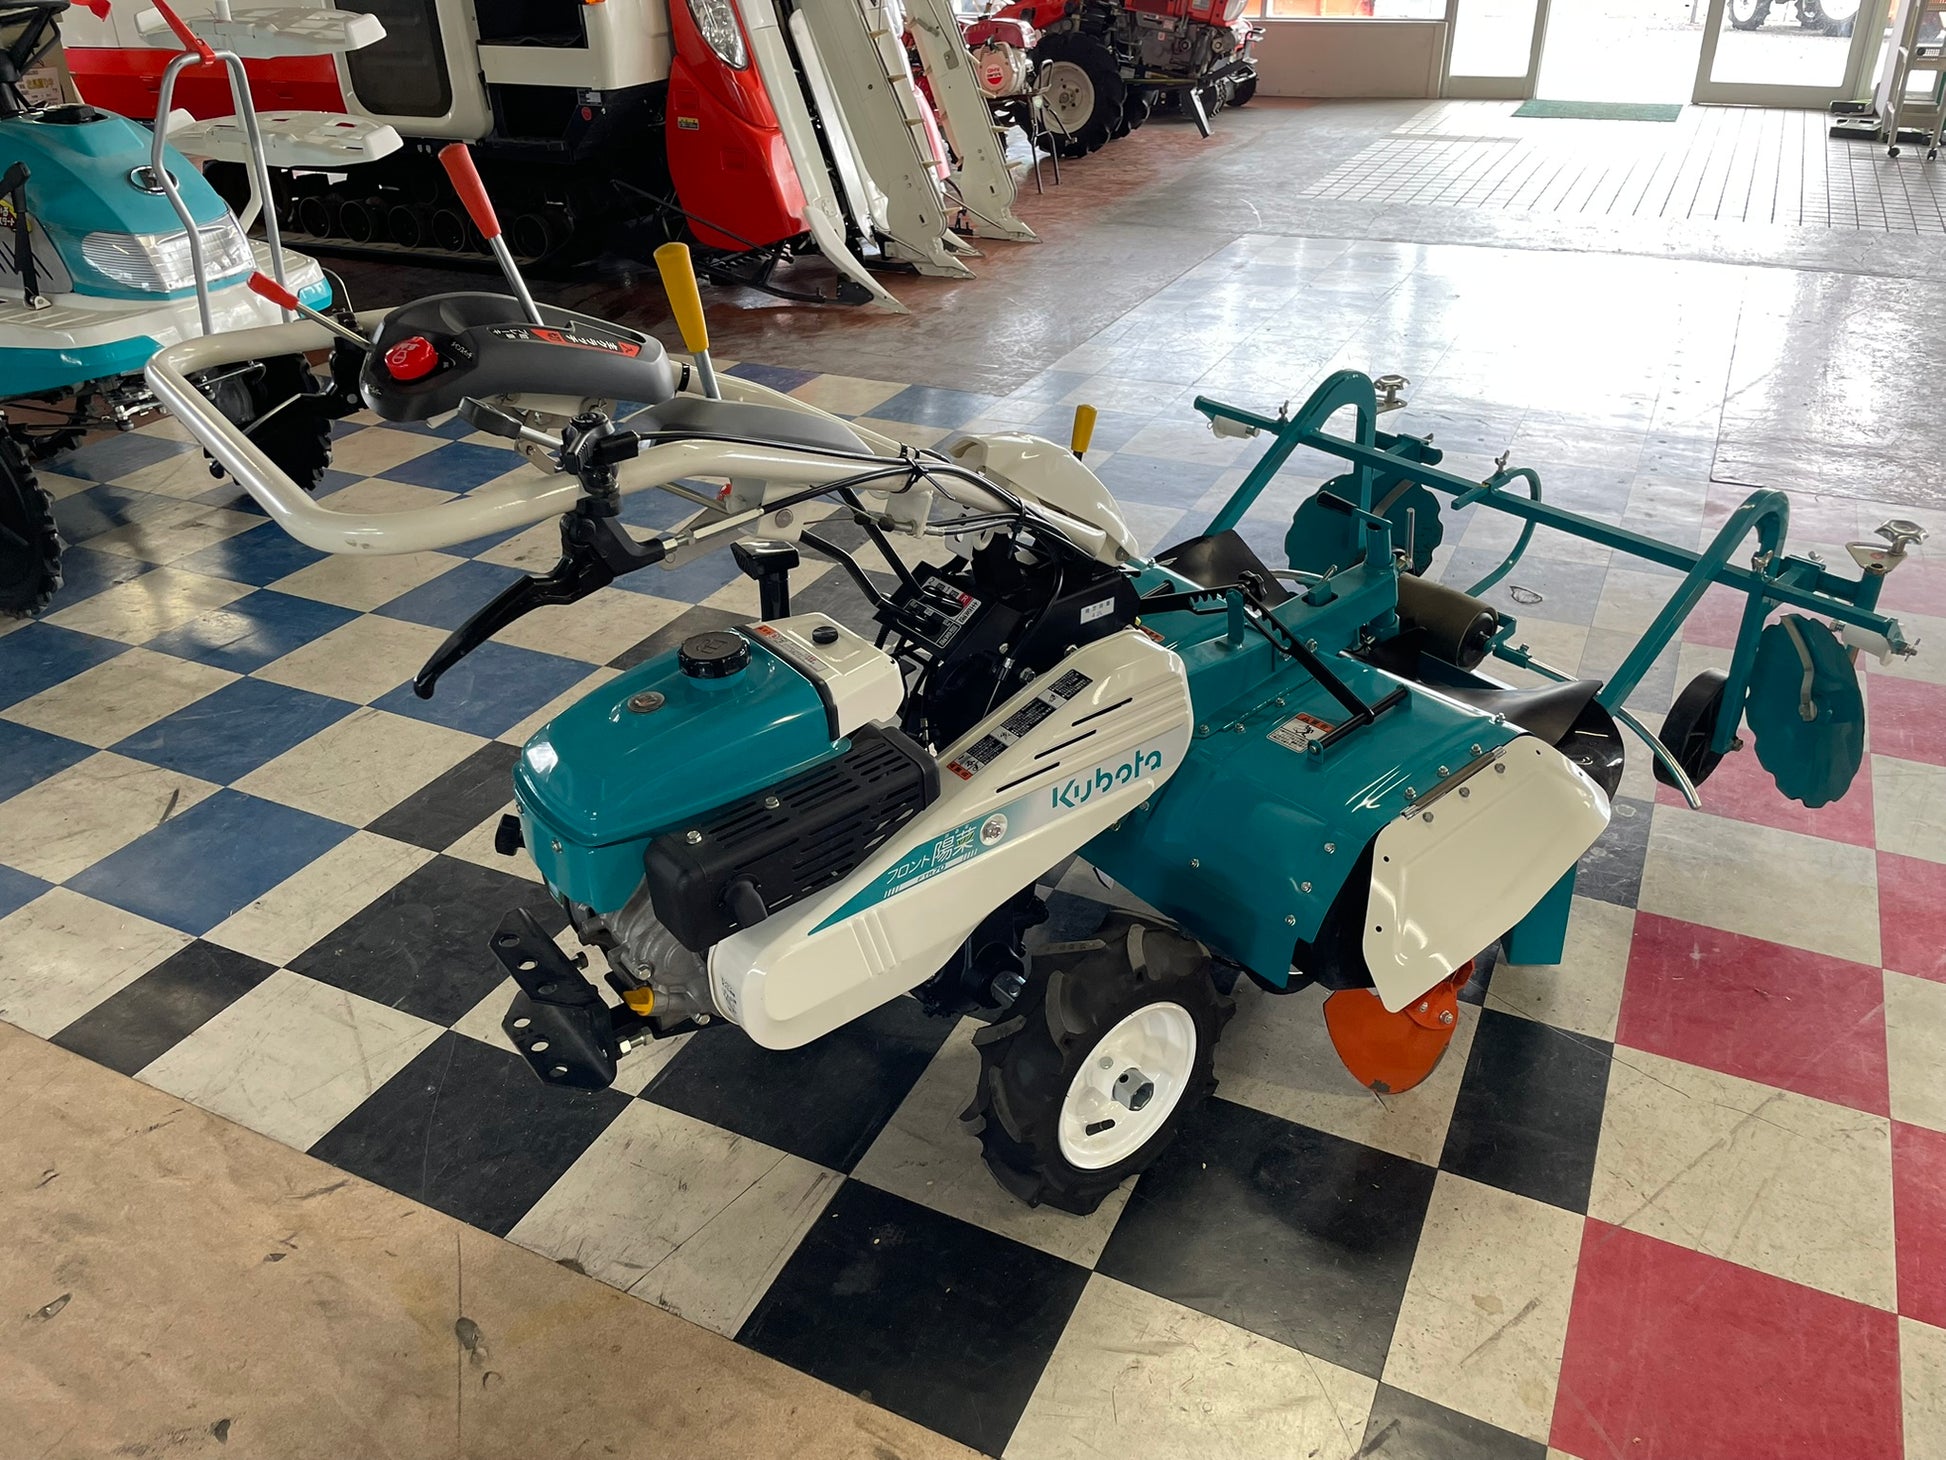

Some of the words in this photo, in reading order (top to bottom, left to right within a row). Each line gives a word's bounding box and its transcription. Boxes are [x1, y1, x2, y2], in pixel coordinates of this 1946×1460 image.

[1052, 750, 1162, 809] Kubota
[886, 826, 977, 885] フロント陽菜
